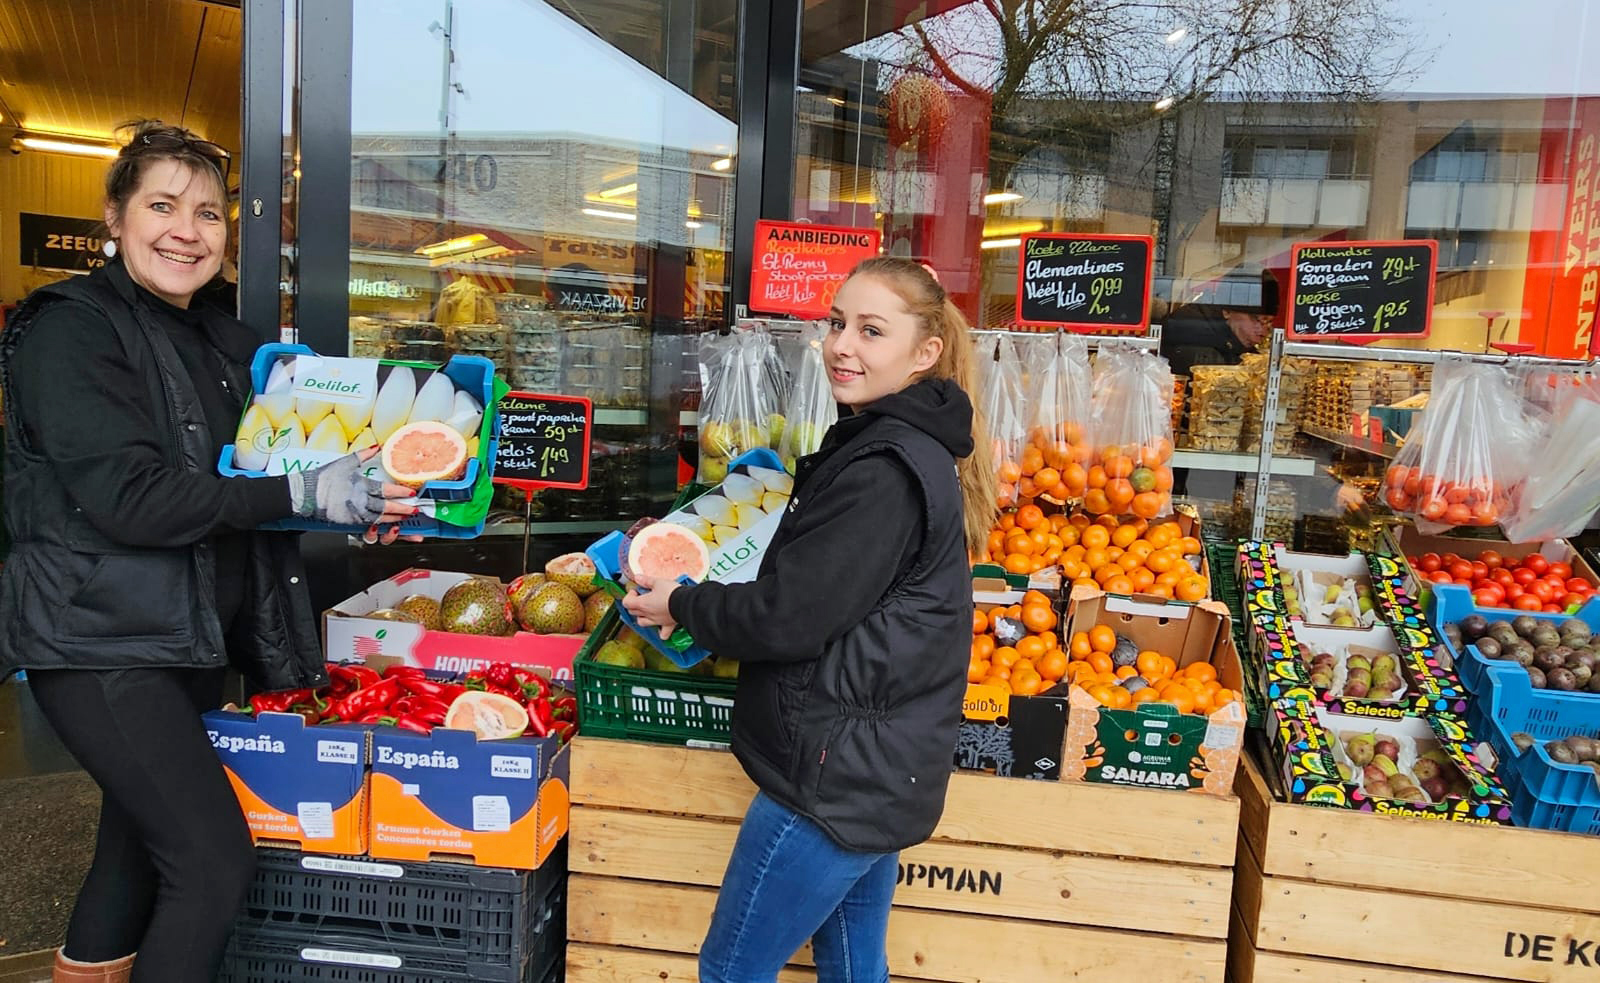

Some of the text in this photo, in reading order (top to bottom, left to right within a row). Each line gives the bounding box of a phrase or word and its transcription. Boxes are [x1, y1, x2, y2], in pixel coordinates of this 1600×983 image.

[1565, 133, 1594, 277] VERS
[46, 234, 104, 252] ZEEU
[768, 228, 869, 247] AANBIEDING
[1300, 247, 1373, 259] Hollandse
[87, 258, 105, 268] va
[1026, 259, 1125, 280] Clementines
[1296, 258, 1373, 273] Tomaten
[1382, 257, 1404, 280] 79
[821, 280, 842, 307] 8
[1330, 316, 1366, 330] stuks
[304, 378, 360, 393] Delilof
[498, 398, 547, 410] eclame
[544, 425, 566, 442] 59
[503, 457, 537, 469] stuk
[207, 730, 286, 754] España
[377, 746, 460, 769] España
[1101, 765, 1190, 787] SAHARA
[1375, 801, 1448, 820] Selected
[376, 823, 461, 838] Krumme Gurken
[376, 833, 437, 846] Concombres
[1504, 931, 1600, 968] DE K
